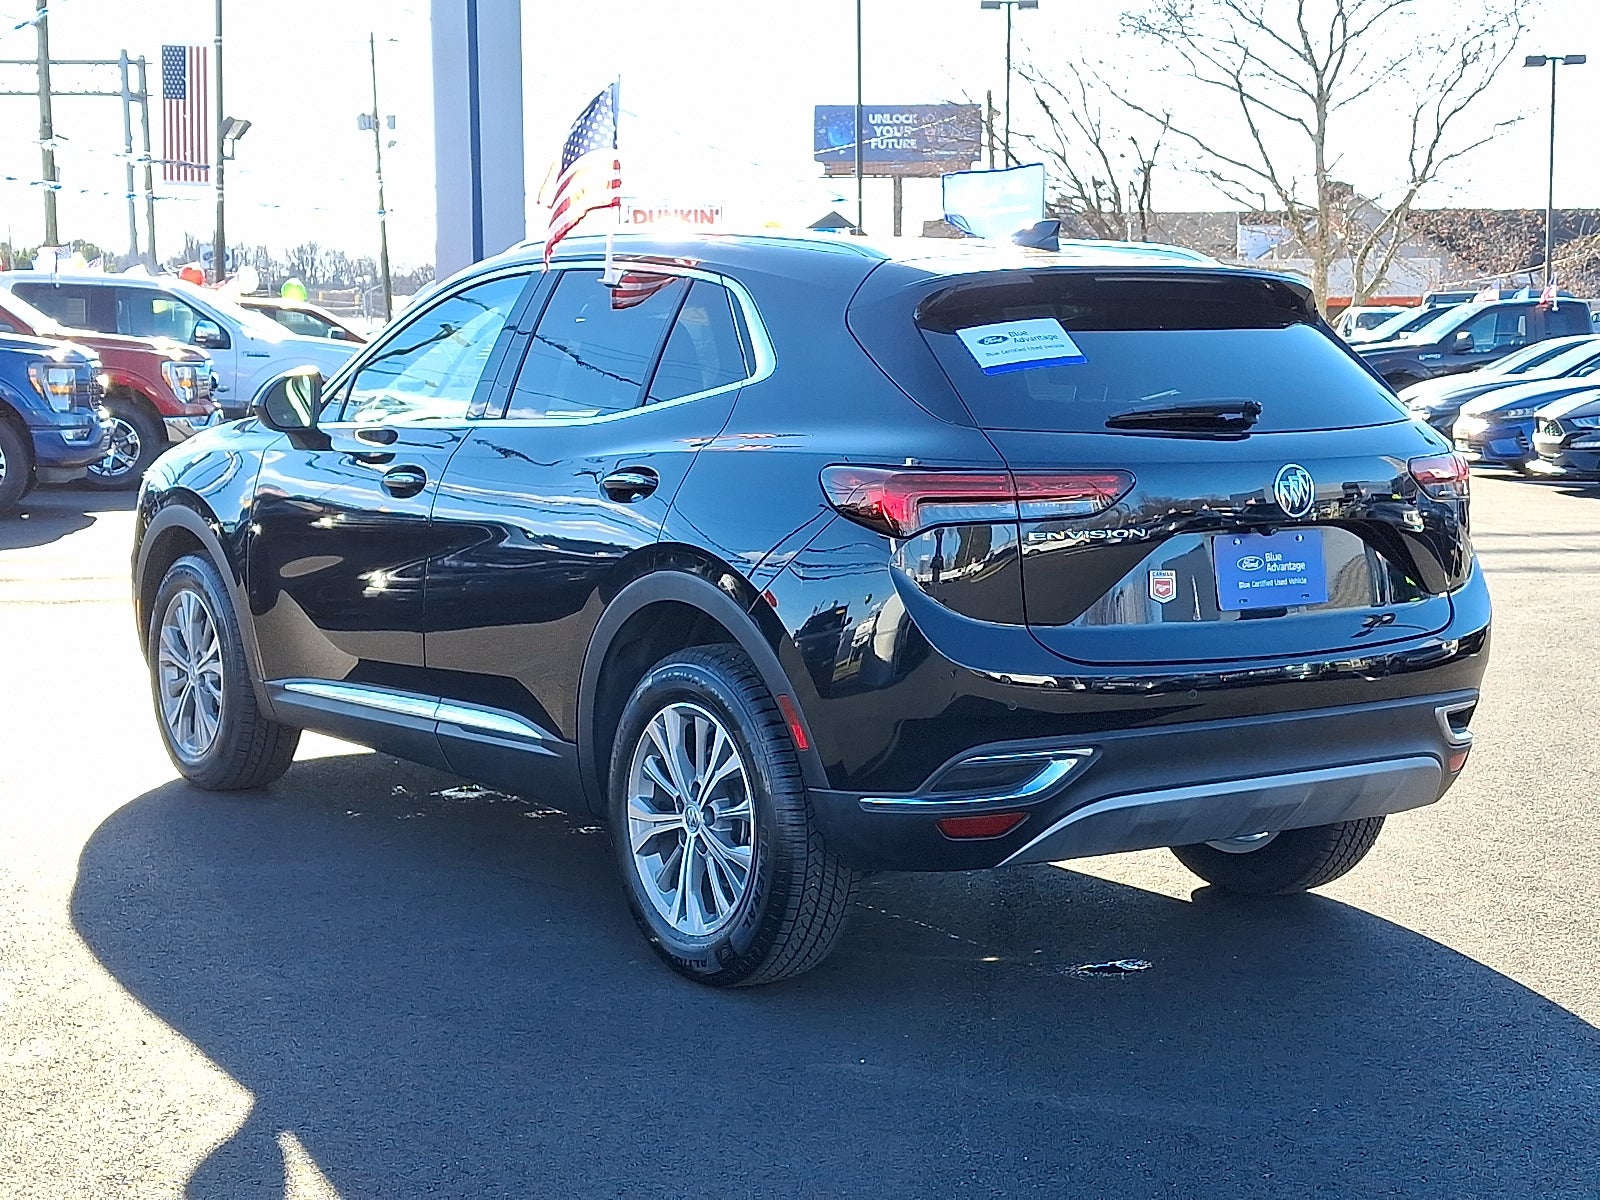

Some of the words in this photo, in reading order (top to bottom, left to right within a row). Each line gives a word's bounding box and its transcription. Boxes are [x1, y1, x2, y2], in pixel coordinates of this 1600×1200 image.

[867, 113, 918, 125] UNLOCK
[873, 126, 913, 138] YOUR
[869, 139, 918, 150] FUTURE
[1008, 330, 1029, 338] Blue
[1013, 333, 1060, 344] Advantage
[1028, 528, 1147, 542] ENVISION
[1264, 551, 1283, 562] Blue
[1266, 561, 1306, 573] Advantage
[1238, 581, 1251, 589] Blue
[1251, 579, 1274, 588] Certified
[1274, 578, 1288, 587] Used
[1288, 576, 1308, 585] Vehicle
